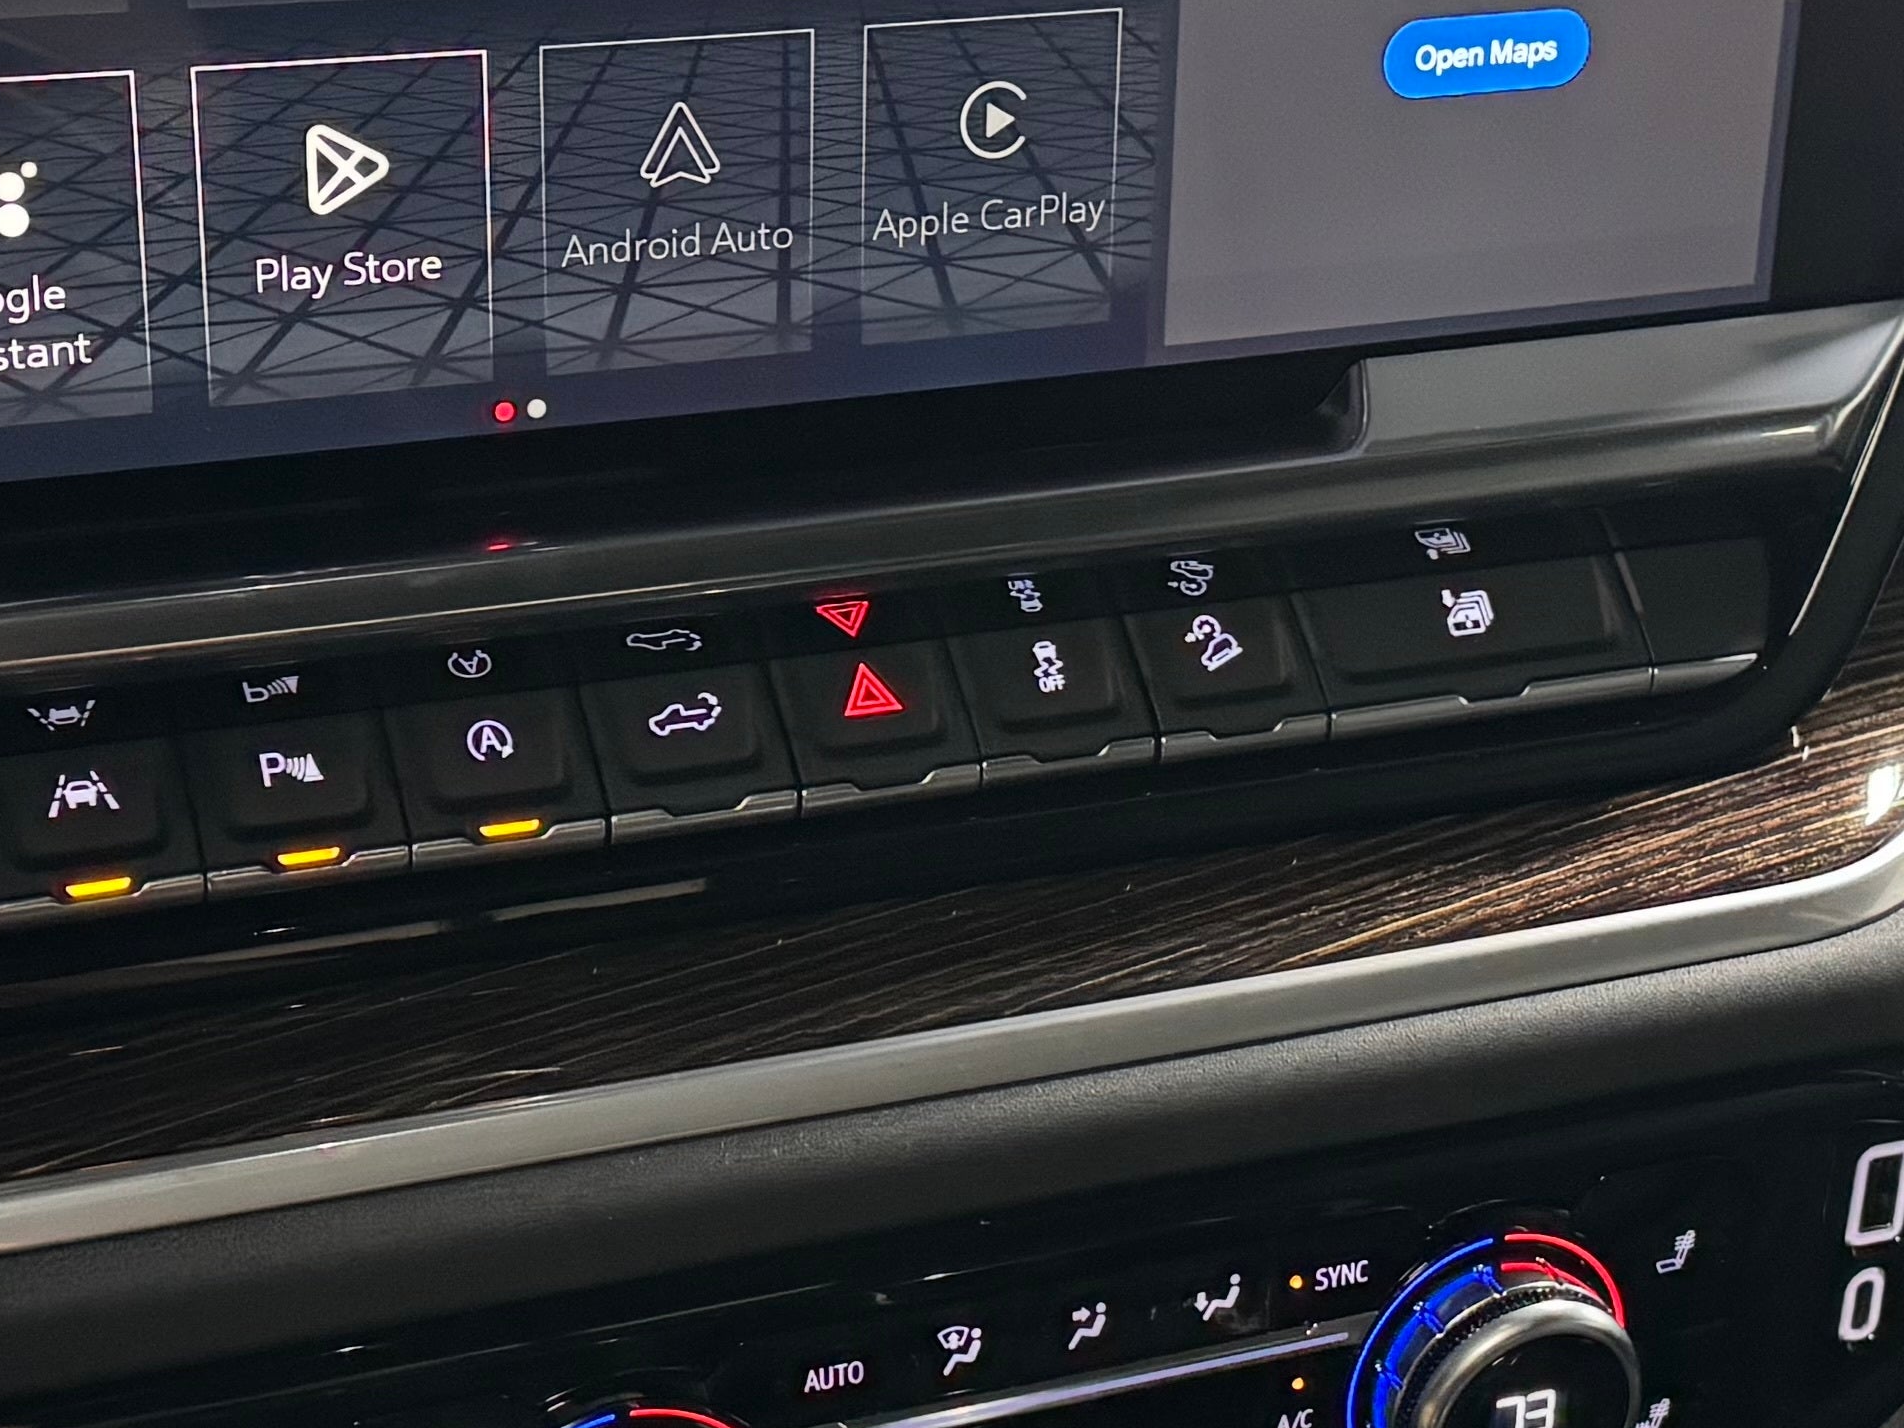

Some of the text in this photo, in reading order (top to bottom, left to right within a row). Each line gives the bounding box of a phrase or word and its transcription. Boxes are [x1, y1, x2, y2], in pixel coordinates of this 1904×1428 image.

[1415, 38, 1558, 76] Open Maps
[872, 191, 1106, 249] Apple CarPlay
[561, 221, 794, 268] Android Auto
[255, 251, 443, 300] Play Store
[1038, 674, 1066, 693] OFF
[1314, 1259, 1369, 1291] SYNC
[804, 1360, 864, 1393] AUTO
